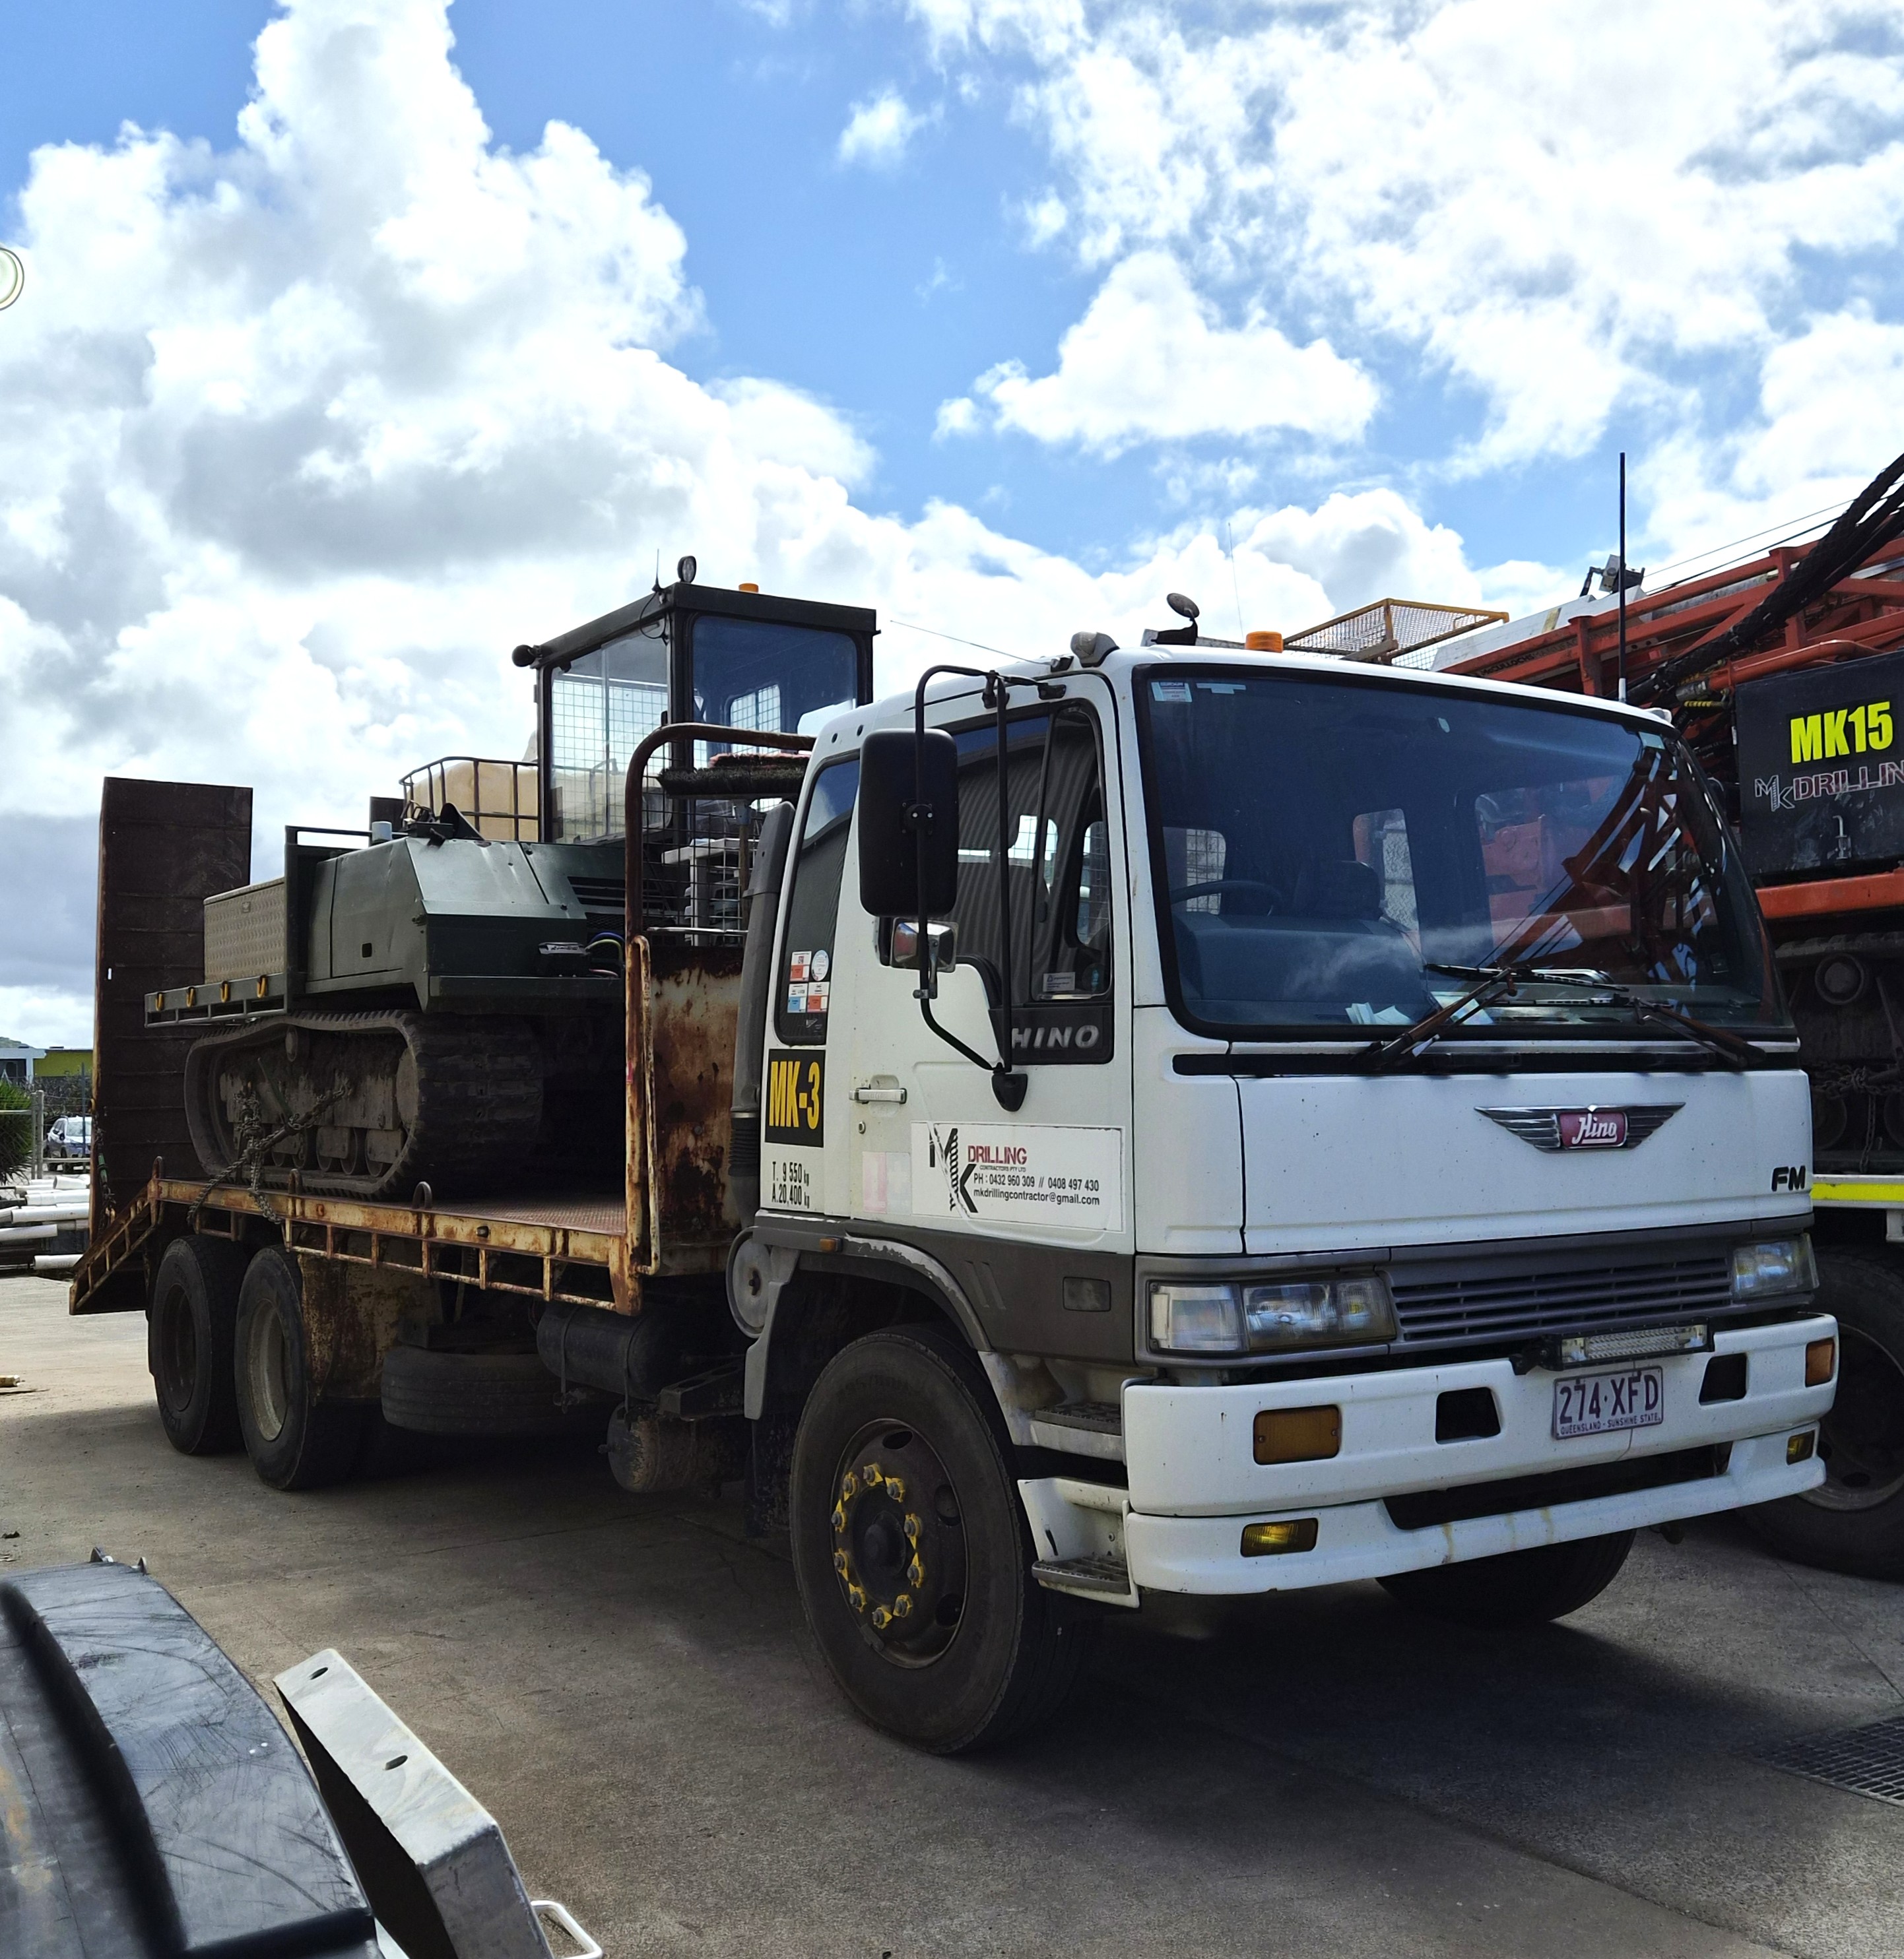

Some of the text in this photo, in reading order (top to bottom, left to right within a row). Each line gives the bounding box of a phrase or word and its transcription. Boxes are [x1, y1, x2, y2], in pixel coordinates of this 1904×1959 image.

[1790, 701, 1893, 764] MK15
[1012, 1025, 1100, 1049] HINO
[769, 1061, 820, 1130] MK-3
[1571, 1113, 1618, 1145] Hino
[967, 1145, 1028, 1165] DRILLING
[973, 1173, 983, 1184] PH
[989, 1174, 1006, 1186] 0432
[1007, 1175, 1020, 1186] 960
[1022, 1175, 1035, 1188] 309
[1048, 1177, 1066, 1190] 0408
[1068, 1178, 1082, 1190] 497
[1084, 1179, 1100, 1192] 430
[1771, 1165, 1806, 1192] FM
[973, 1188, 1100, 1205] mkdrillingcontractor@gmail.com
[1560, 1420, 1602, 1436] QUEENSLAND
[1607, 1417, 1637, 1429] SUNSHINE
[1640, 1413, 1658, 1423] STATE
